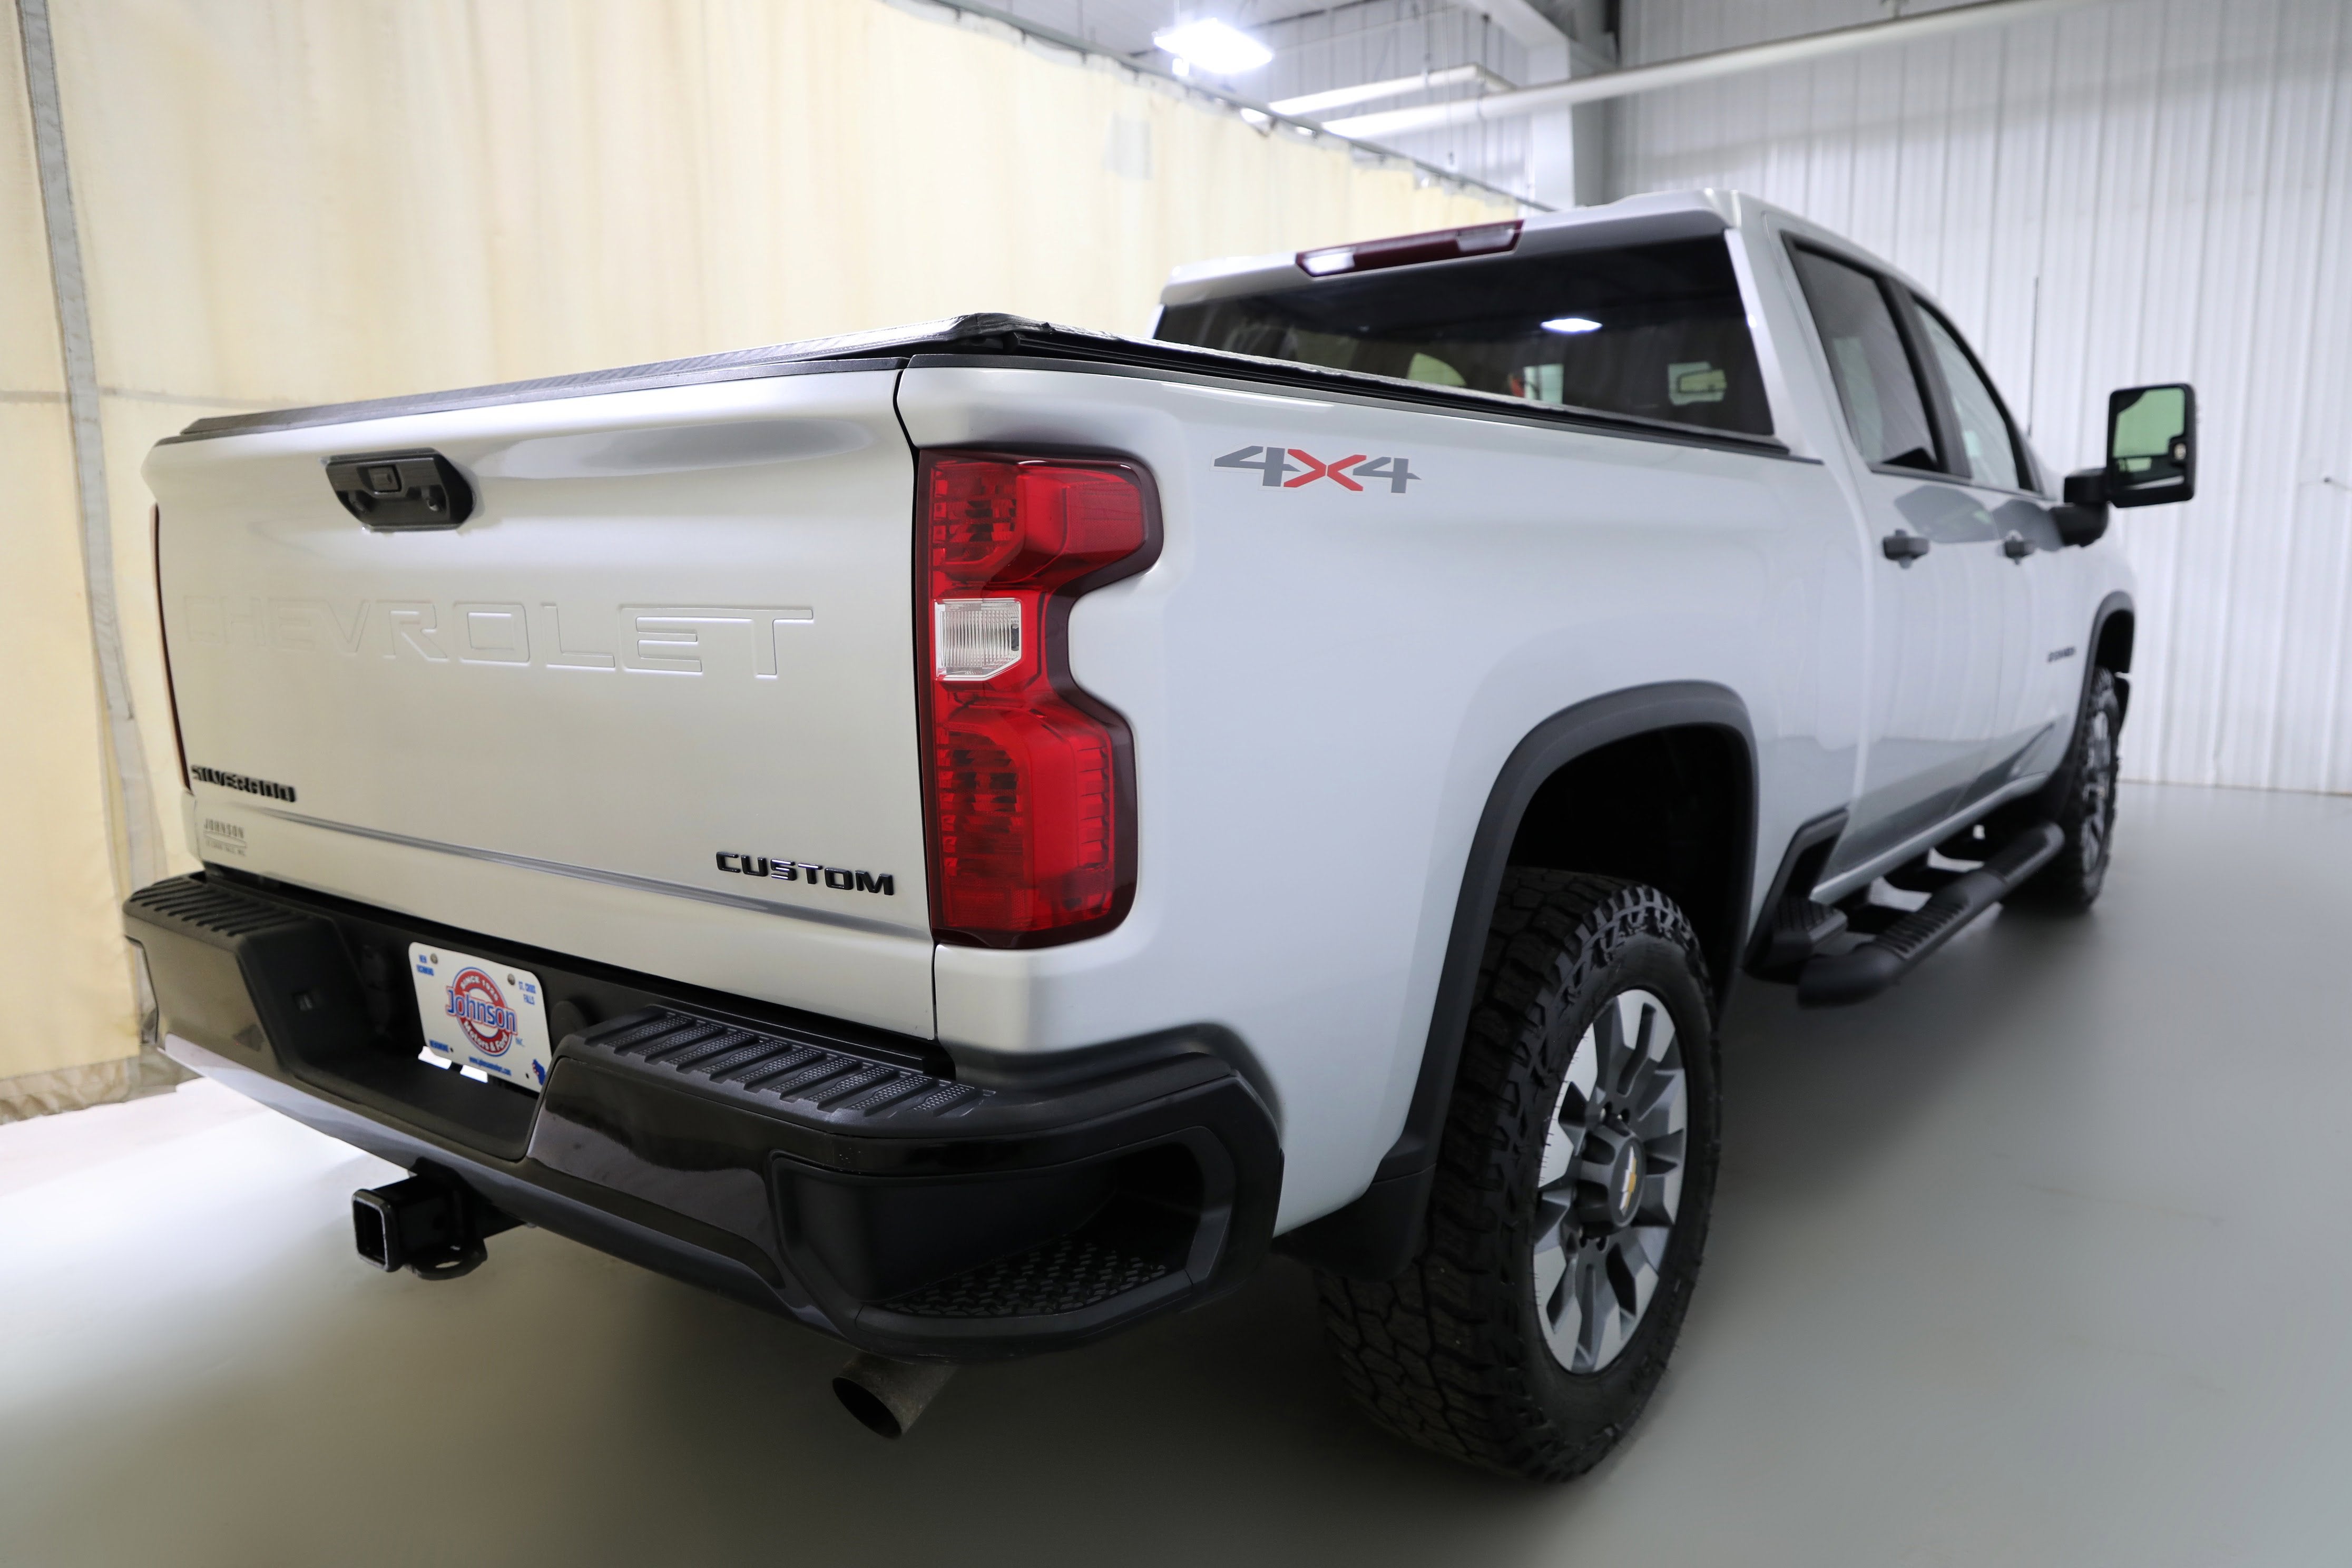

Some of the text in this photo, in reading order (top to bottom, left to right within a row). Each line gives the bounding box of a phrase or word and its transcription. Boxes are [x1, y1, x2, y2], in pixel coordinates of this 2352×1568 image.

[183, 593, 814, 679] CHEVROLET
[203, 818, 244, 839] JOHNSON
[716, 851, 894, 896] CUSTOM
[460, 975, 481, 989] SINCE
[447, 988, 517, 1033] Johnson
[464, 1021, 490, 1051] Motors
[489, 1041, 496, 1052] &
